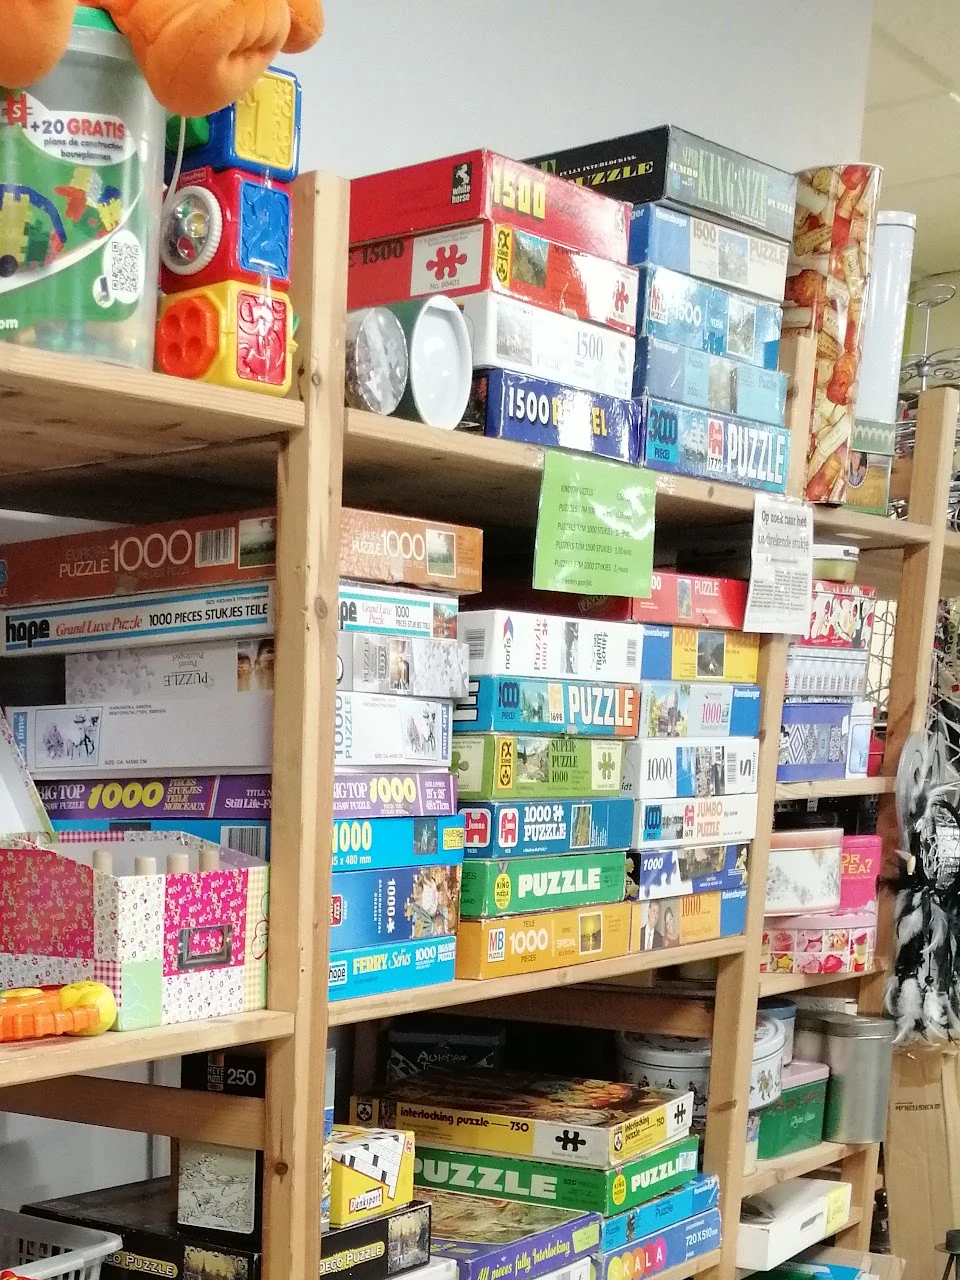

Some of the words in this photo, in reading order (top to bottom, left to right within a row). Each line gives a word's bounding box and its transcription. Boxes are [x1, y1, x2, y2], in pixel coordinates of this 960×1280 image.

[67, 117, 126, 140] GRATIS
[573, 160, 654, 188] UZZLE
[452, 185, 471, 195] white
[452, 194, 471, 204] horse
[492, 164, 546, 221] 1500
[693, 220, 717, 244] 1500
[362, 239, 405, 265] 1500
[749, 238, 787, 266] PUZZLE
[576, 329, 604, 362] 1500
[508, 387, 550, 425] 1500
[727, 424, 786, 484] PUZZLE
[761, 510, 770, 525] Op
[784, 514, 796, 526] naar
[796, 515, 808, 527] het
[58, 557, 111, 579] PUZZLE
[108, 528, 193, 573] 1000
[381, 530, 426, 561] 1000
[792, 533, 809, 554] stukje
[694, 579, 720, 597] PUZZLE
[394, 605, 410, 618] 1000
[5, 615, 51, 649] hope
[55, 622, 86, 638] Grand
[86, 619, 111, 635] Luxe
[112, 615, 143, 633] Puzzle
[148, 611, 173, 628] 1000
[174, 609, 203, 625] PIECES
[204, 606, 244, 621] STUKJES
[244, 602, 269, 617] TEILE
[503, 636, 512, 670] noris
[533, 617, 542, 671] Puzzle
[163, 671, 209, 688] PUZZLE
[733, 687, 761, 700] Ravensburger
[441, 703, 450, 726] play
[567, 685, 634, 727] PUZZLE
[701, 702, 722, 724] 1000
[549, 711, 563, 722] 1698
[344, 695, 353, 759] PUZZLE
[550, 754, 579, 769] PUZZLE
[646, 756, 673, 782] 1000
[550, 769, 569, 784] 1000
[58, 784, 85, 800] TOP
[88, 781, 165, 810] 1000
[166, 793, 189, 803] TEILE
[167, 785, 203, 795] STUKJES
[245, 789, 266, 798] TITLE
[346, 782, 368, 799] TOP
[369, 776, 417, 804] 1000
[61, 800, 85, 811] PUZZLE
[163, 802, 206, 812] MORCEAUX
[350, 801, 372, 810] PUZZLE
[523, 804, 551, 823] 1000
[696, 801, 723, 818] JUMBO
[331, 820, 373, 854] 1000
[523, 822, 567, 842] PUZZLE
[696, 820, 720, 838] PUZZLE
[345, 854, 358, 865] 480
[359, 855, 372, 864] mm
[643, 857, 664, 871] 1000
[841, 852, 860, 864] OR
[841, 858, 873, 875] TEA?
[496, 881, 510, 890] KING
[518, 867, 601, 899] PUZZLE
[386, 878, 397, 917] 1000
[681, 894, 701, 918] 1000
[522, 919, 536, 928] TEILE
[490, 930, 505, 953] MB
[509, 927, 549, 955] 1000
[352, 953, 388, 976] FERRY
[414, 945, 437, 962] 1000
[488, 951, 504, 961] PUZZLE
[520, 954, 537, 963] PIECES
[207, 1066, 225, 1076] HEYE
[227, 1068, 257, 1087] 250
[400, 1105, 455, 1126] interlocking
[456, 1115, 490, 1128] puzzle
[509, 1120, 530, 1133] 750
[623, 1115, 650, 1133] interlocking
[655, 1116, 665, 1127] 750
[624, 1126, 641, 1141] puzzle
[349, 1192, 383, 1212] Denksport
[655, 1203, 675, 1218] Puzzle
[345, 1245, 383, 1265] PUZZLE
[514, 1253, 531, 1278] fully
[531, 1240, 571, 1265] Interlocking
[609, 1245, 665, 1280] SKALA
[126, 1255, 176, 1276] PUZZLE
